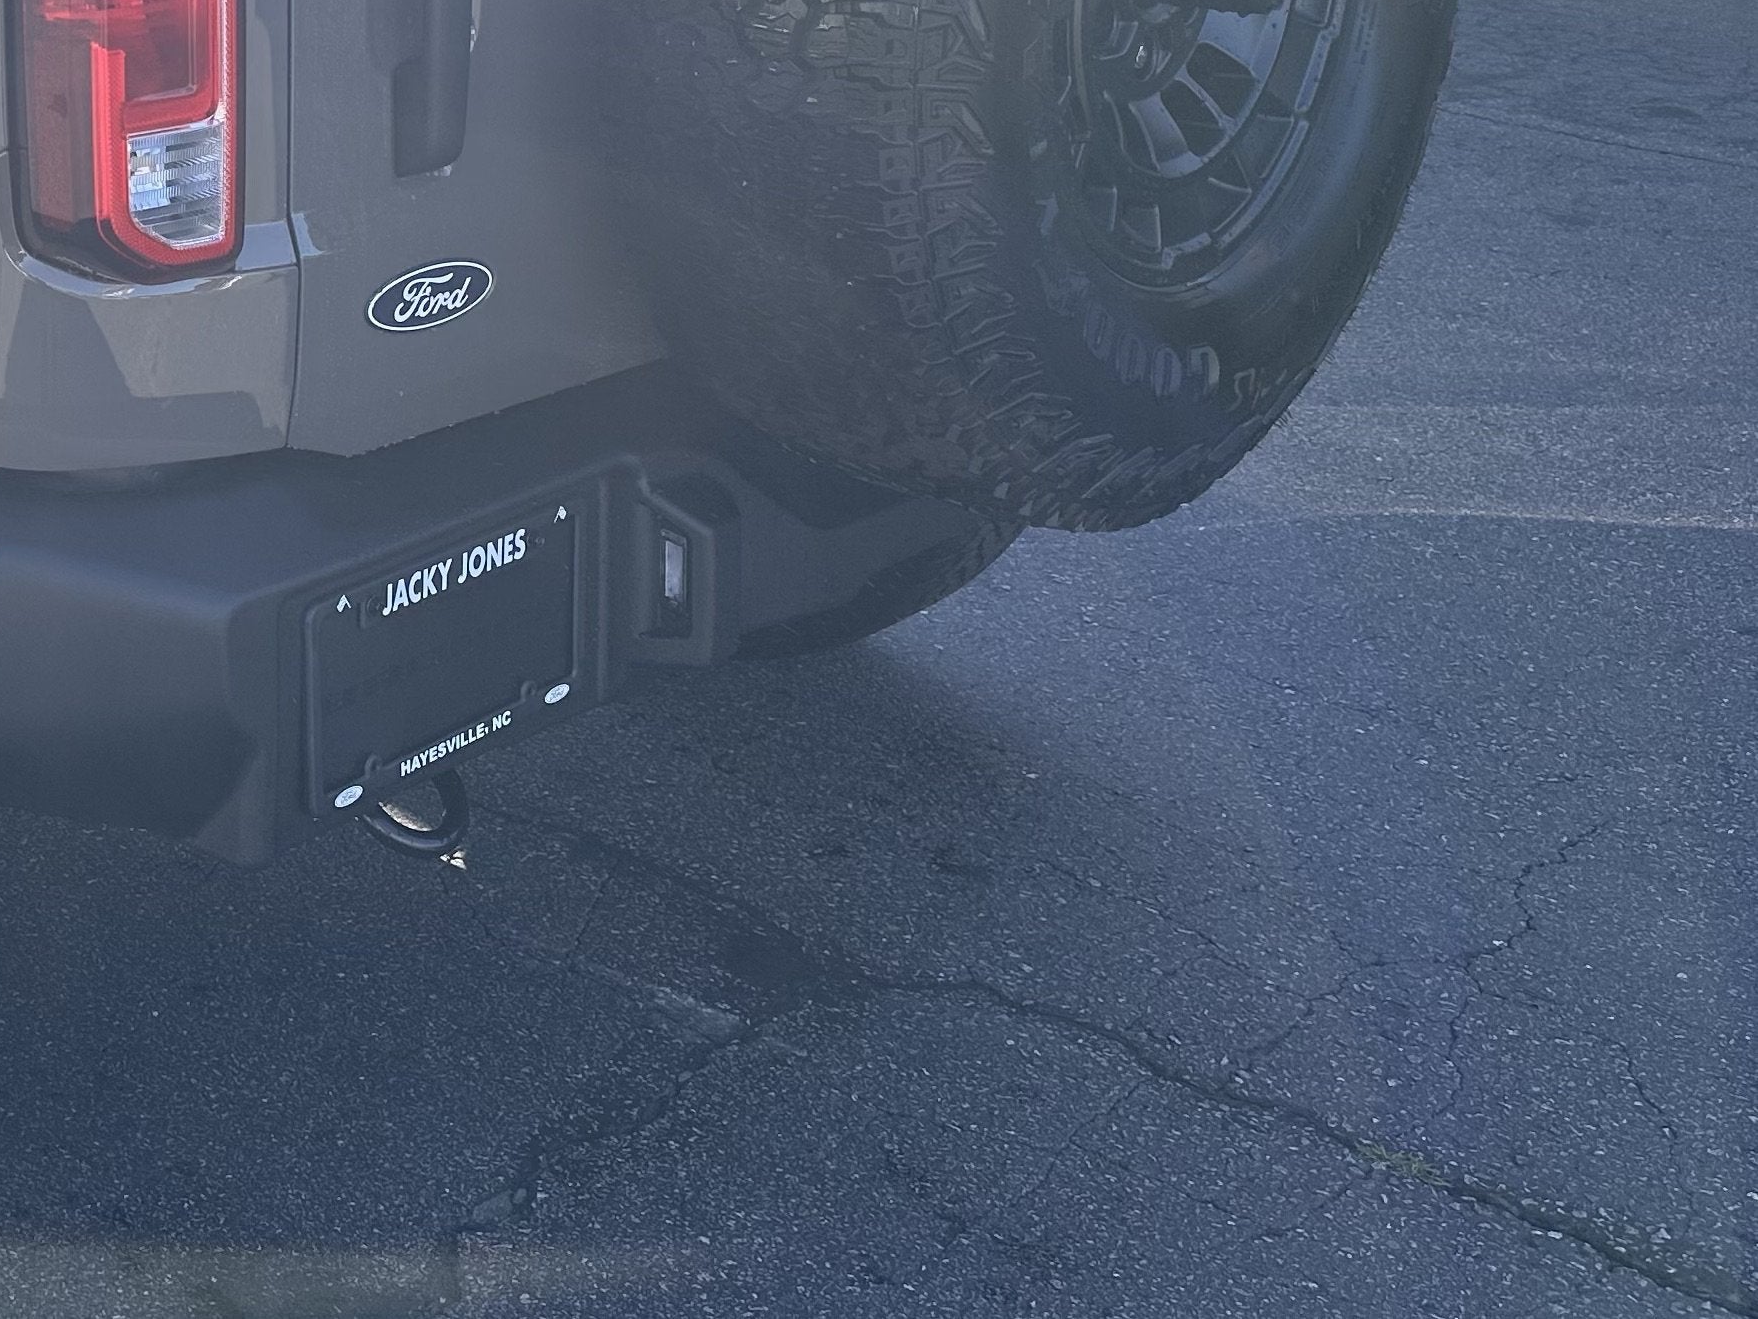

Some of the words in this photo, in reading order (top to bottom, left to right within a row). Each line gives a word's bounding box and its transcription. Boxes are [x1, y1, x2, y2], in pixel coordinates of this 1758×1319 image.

[394, 272, 471, 323] Ford
[382, 558, 453, 616] JACKY
[457, 528, 527, 584] JONES
[400, 721, 489, 777] HAYESVILLE,
[492, 710, 512, 732] NC
